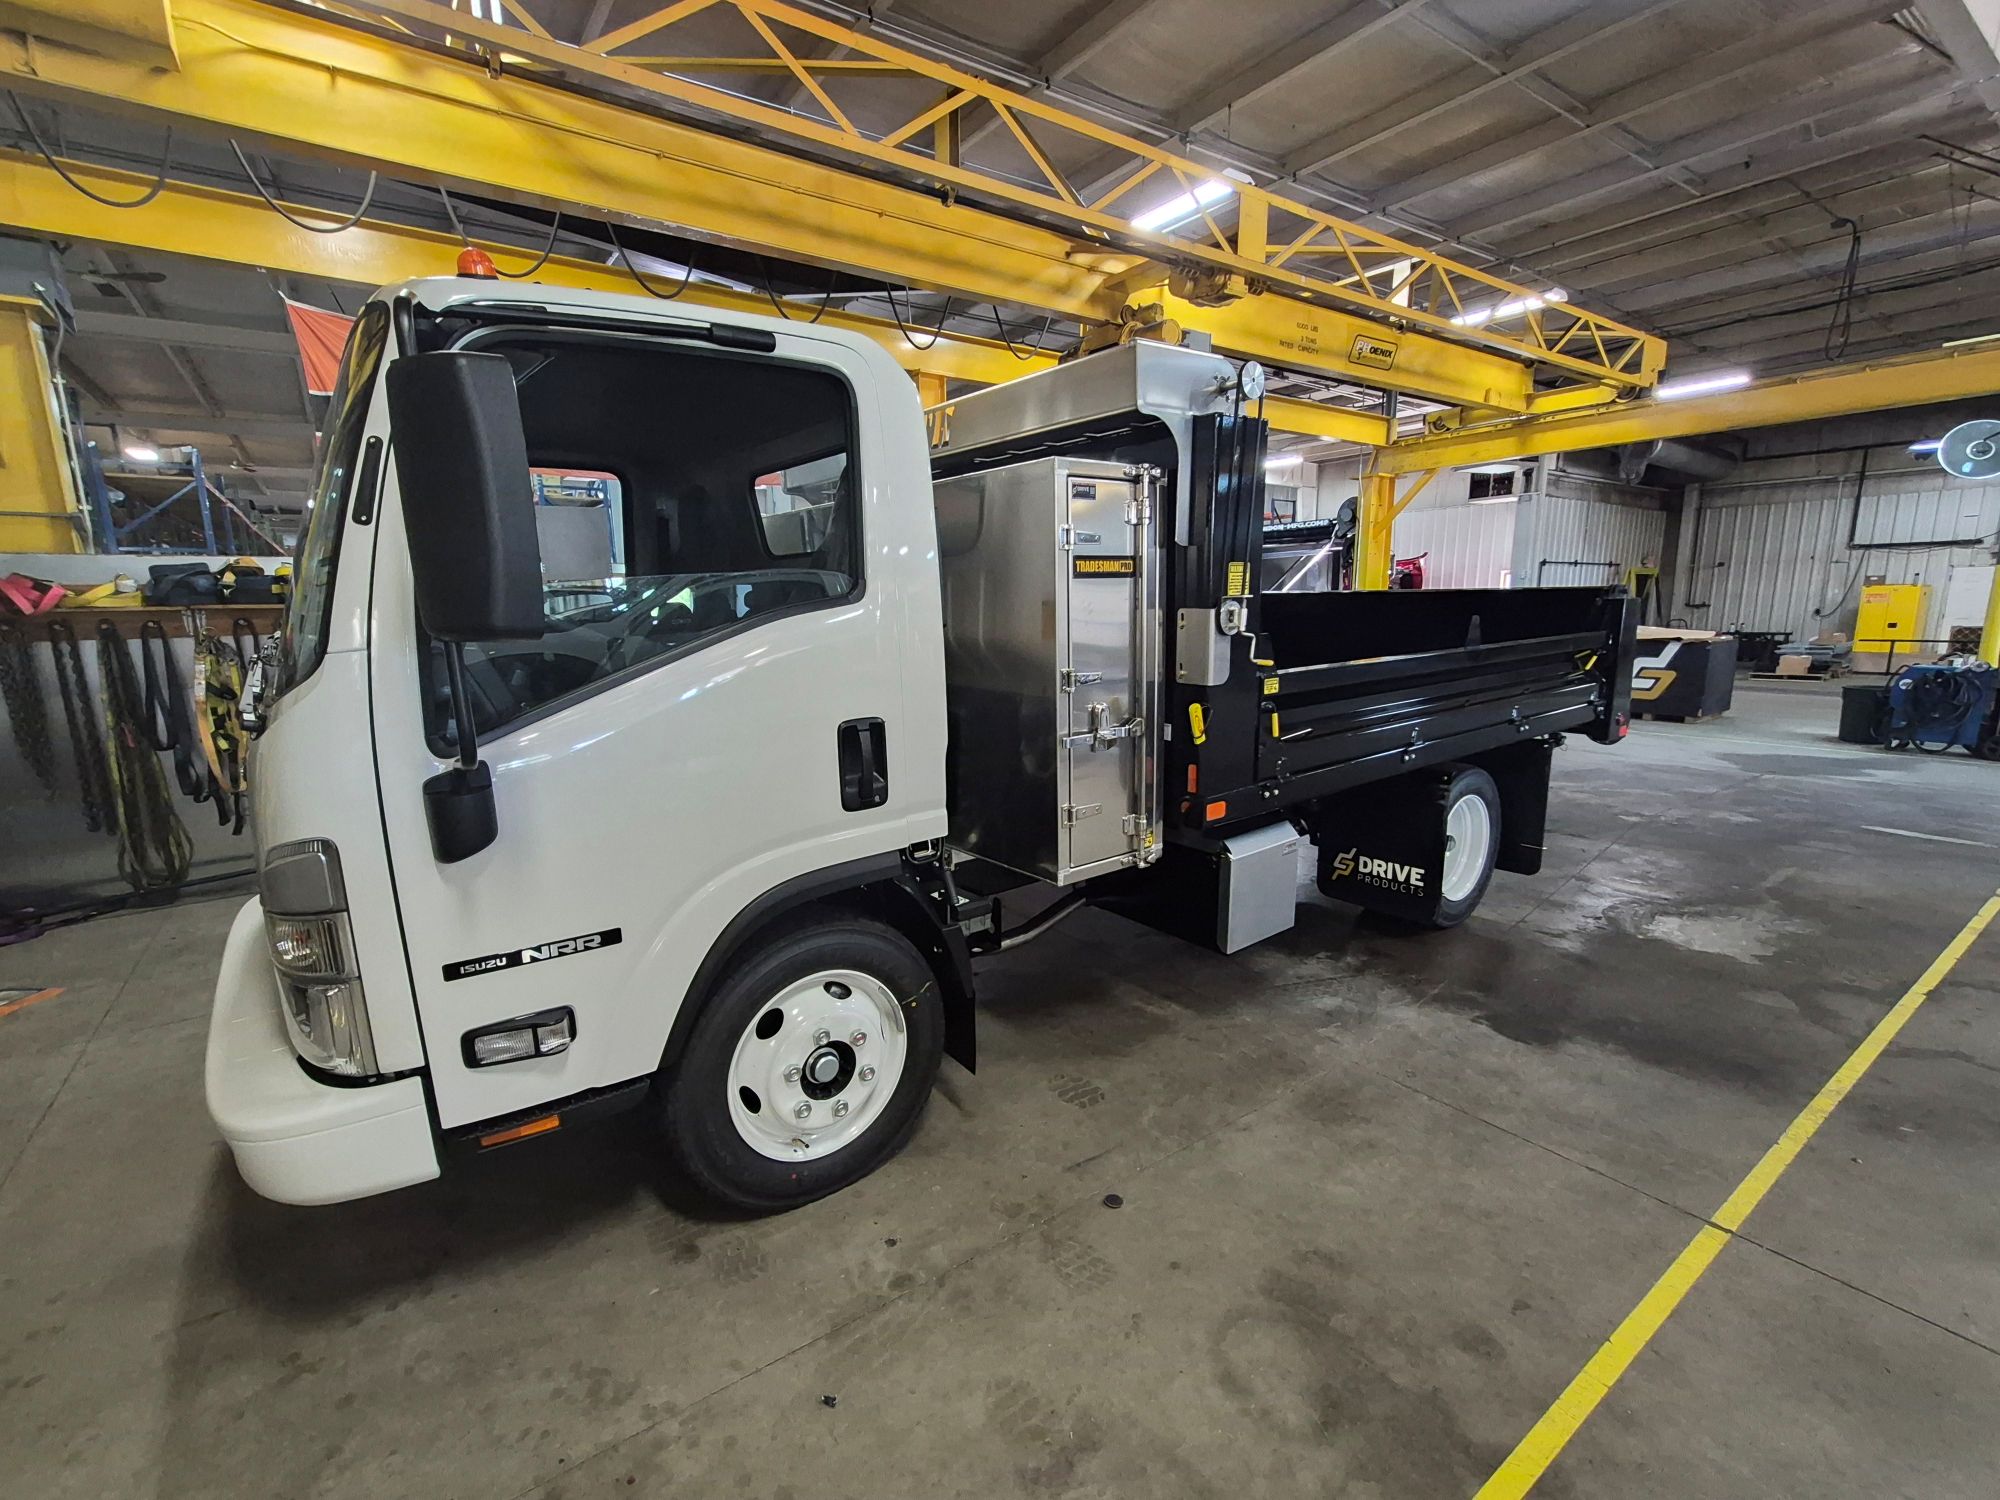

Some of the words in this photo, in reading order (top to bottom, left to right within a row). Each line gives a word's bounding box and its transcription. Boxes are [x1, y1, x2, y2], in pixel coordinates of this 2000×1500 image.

[1356, 340, 1394, 359] PHOENIX
[1075, 560, 1119, 573] TRADESMAN
[1120, 561, 1132, 571] PRO
[1358, 855, 1425, 887] DRIVE
[1357, 873, 1424, 897] PRODUCTS
[459, 957, 507, 975] ISUZU
[521, 934, 602, 964] NRR
